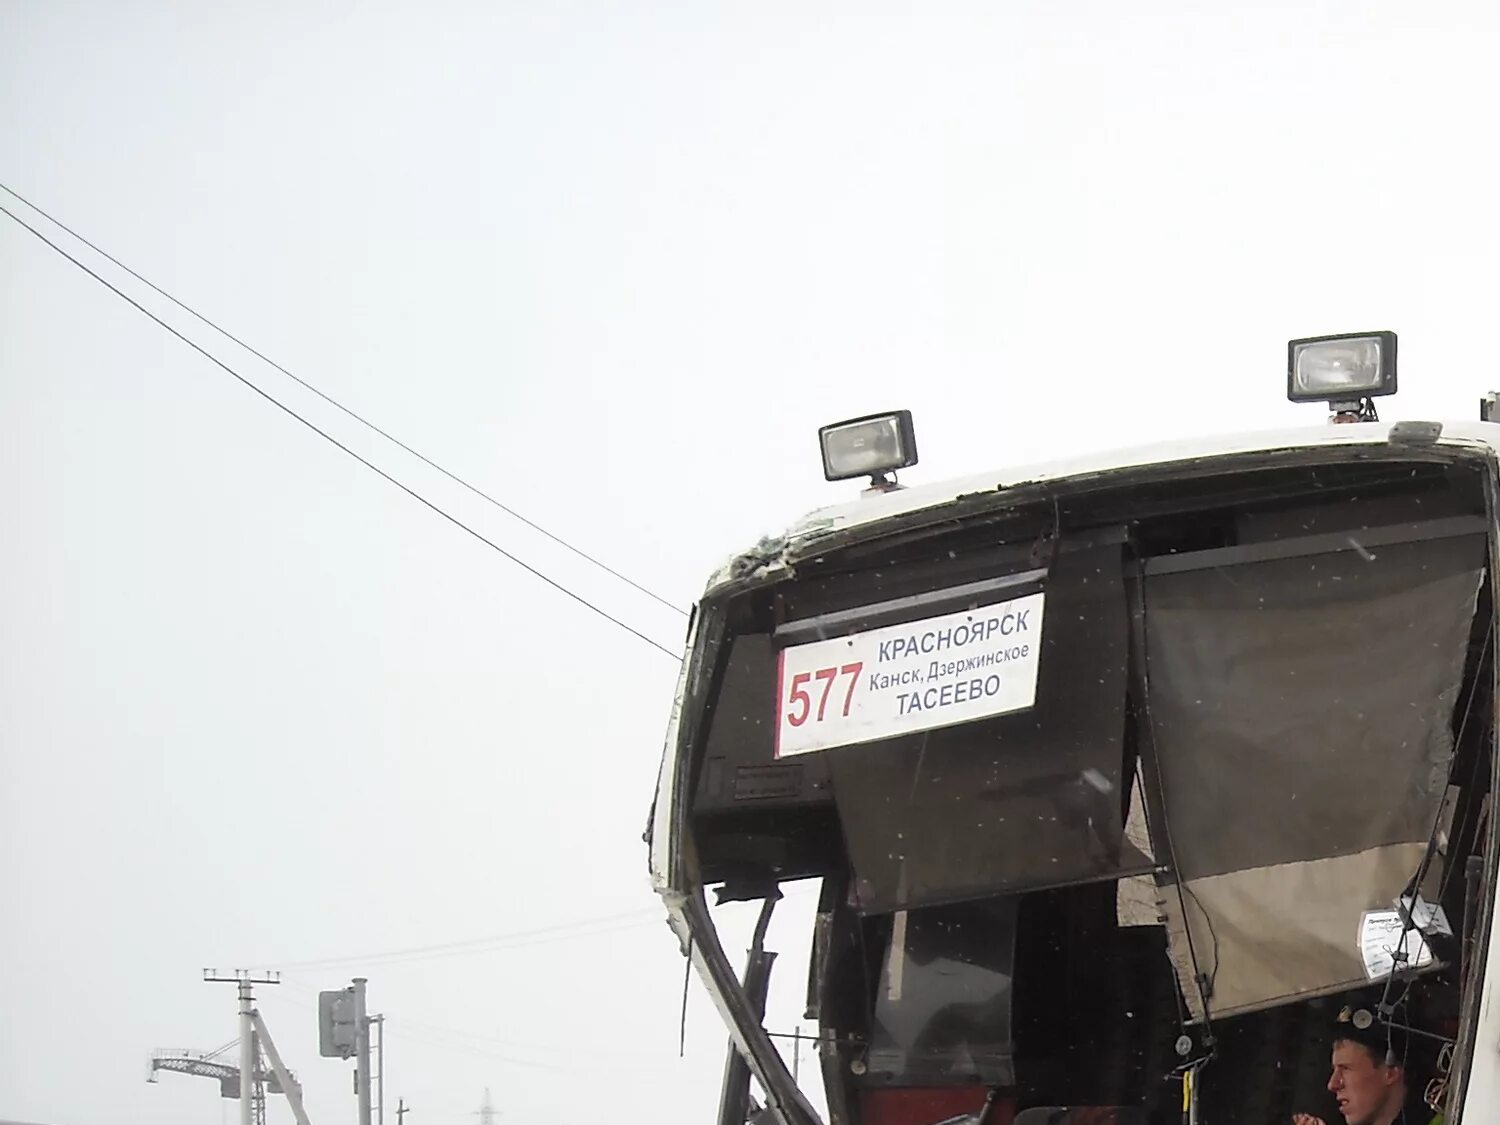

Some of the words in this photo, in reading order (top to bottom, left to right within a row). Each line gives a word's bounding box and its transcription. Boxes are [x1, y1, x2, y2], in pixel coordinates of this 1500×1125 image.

[878, 610, 1030, 663] КРАСНОЯРСК
[869, 667, 924, 692] Канск,
[927, 644, 1030, 684] Дзержинское
[787, 661, 864, 728] 577
[896, 674, 1001, 716] ТАСЕЕВО
